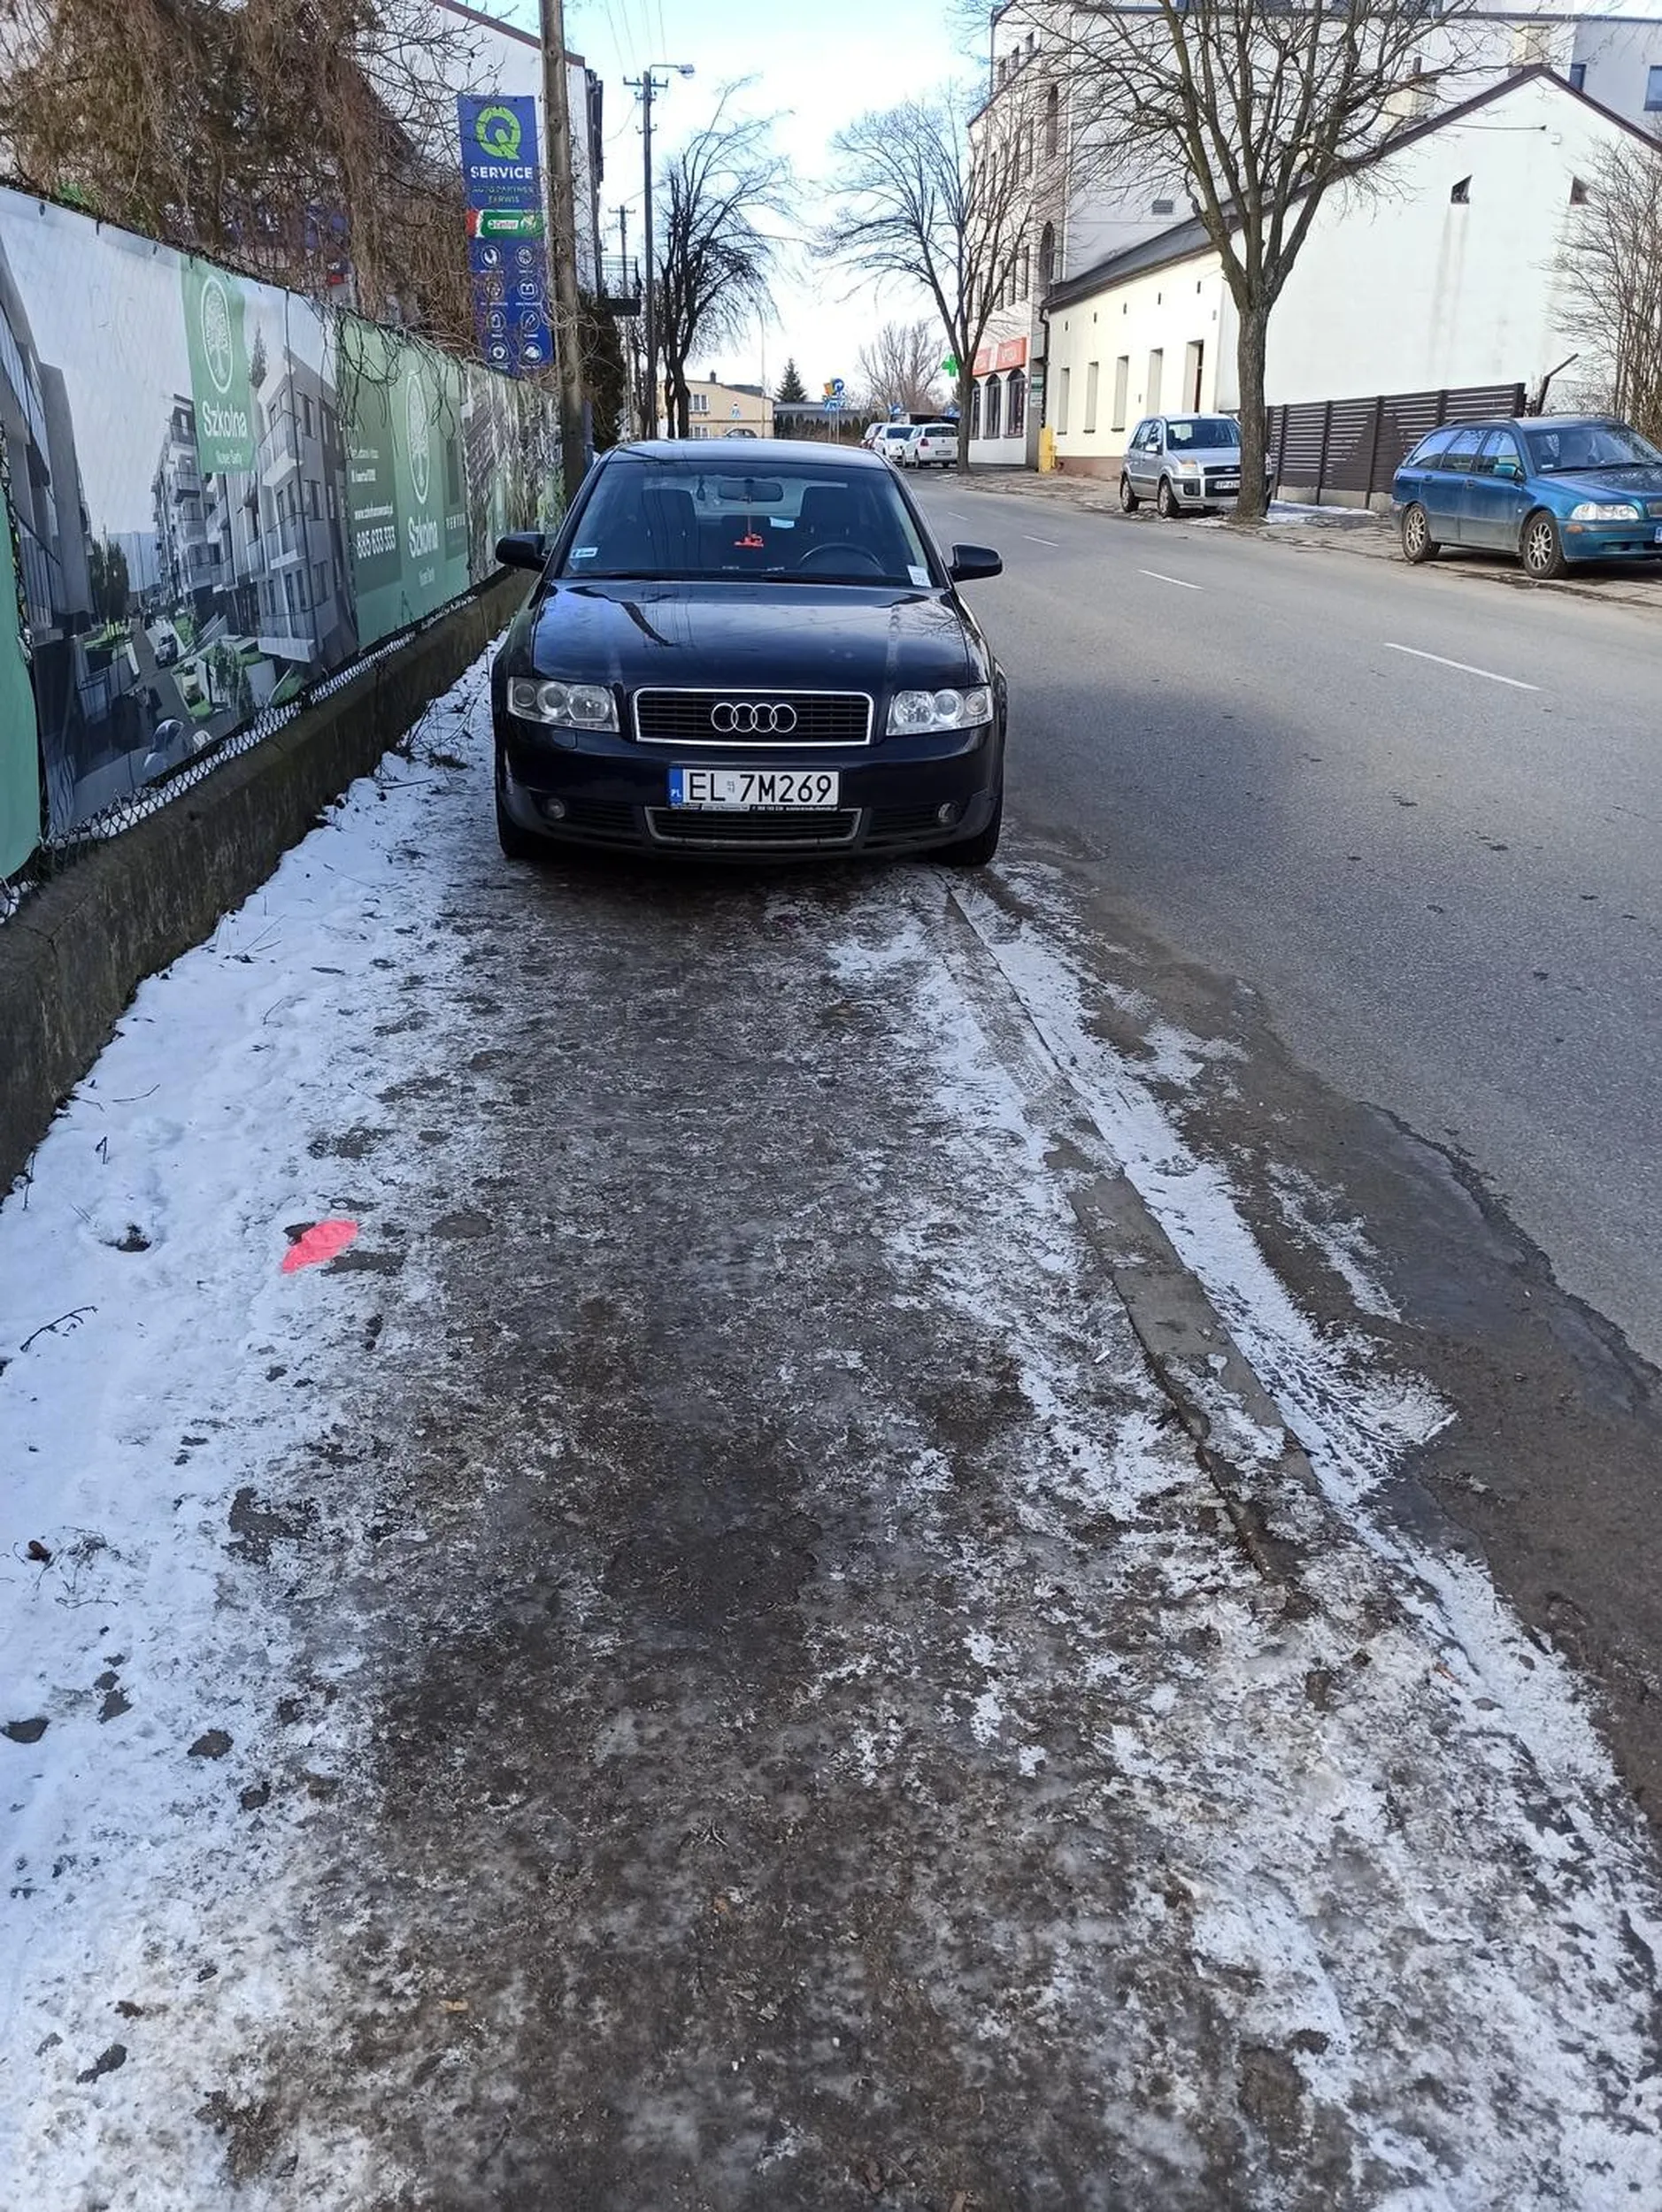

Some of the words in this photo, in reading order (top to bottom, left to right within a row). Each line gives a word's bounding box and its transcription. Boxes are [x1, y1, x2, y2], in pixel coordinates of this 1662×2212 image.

[470, 165, 534, 180] SERVICE
[202, 400, 249, 438] Szkolna
[408, 512, 439, 558] Szkolna
[670, 788, 682, 798] PL
[689, 772, 726, 802] EL
[740, 774, 832, 803] 7M269
